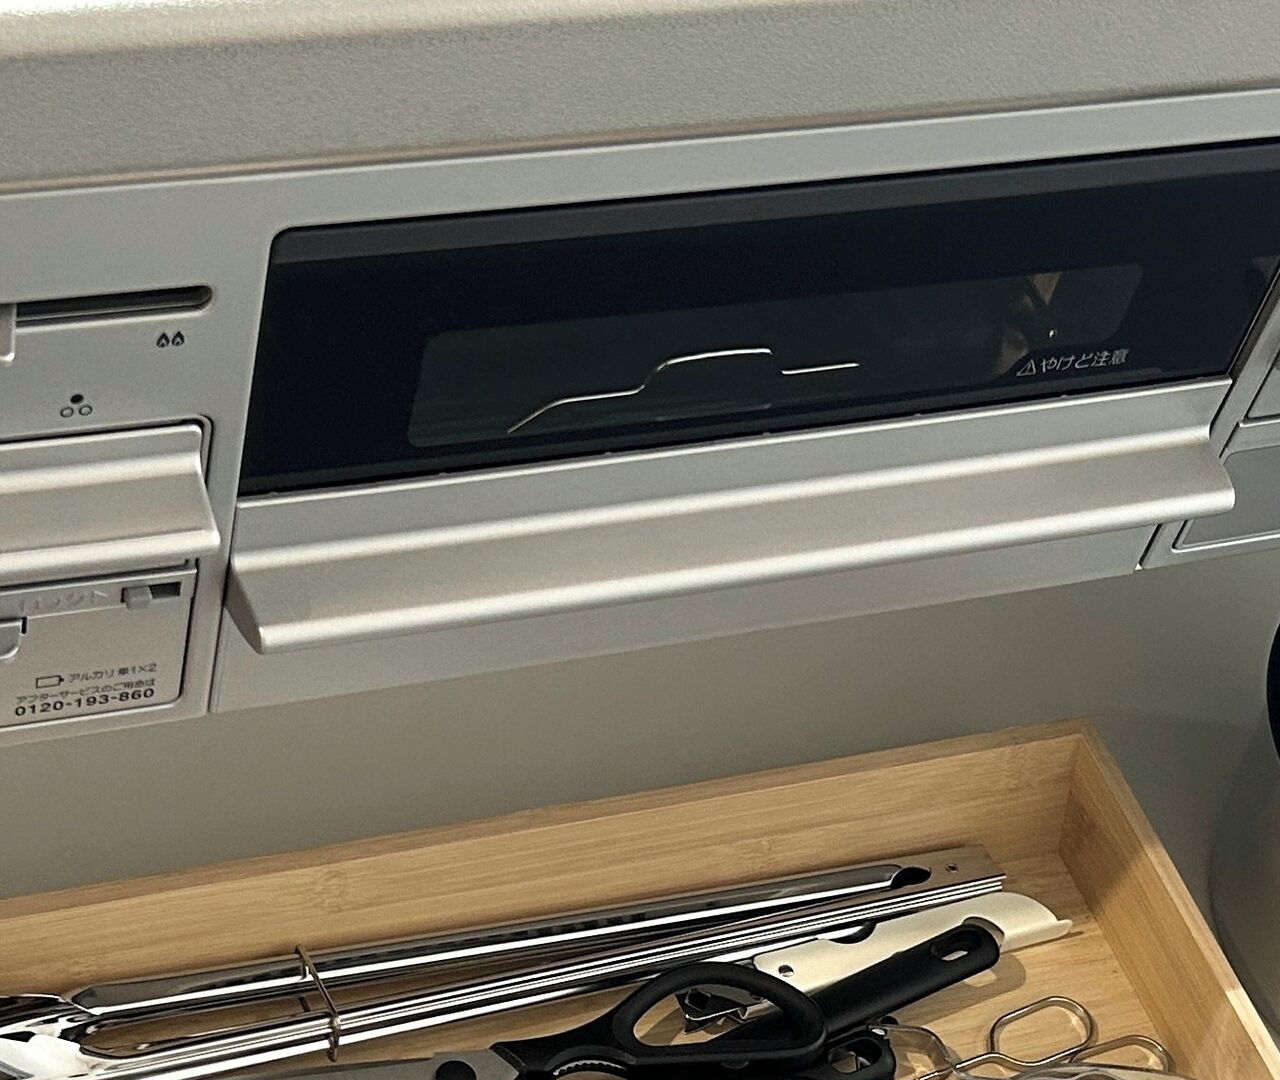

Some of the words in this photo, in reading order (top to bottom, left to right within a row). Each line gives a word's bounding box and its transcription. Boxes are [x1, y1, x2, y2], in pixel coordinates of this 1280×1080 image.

[1041, 348, 1129, 373] やけど注意
[68, 669, 115, 683] アルカリ
[15, 688, 155, 716] 0120-193-860
